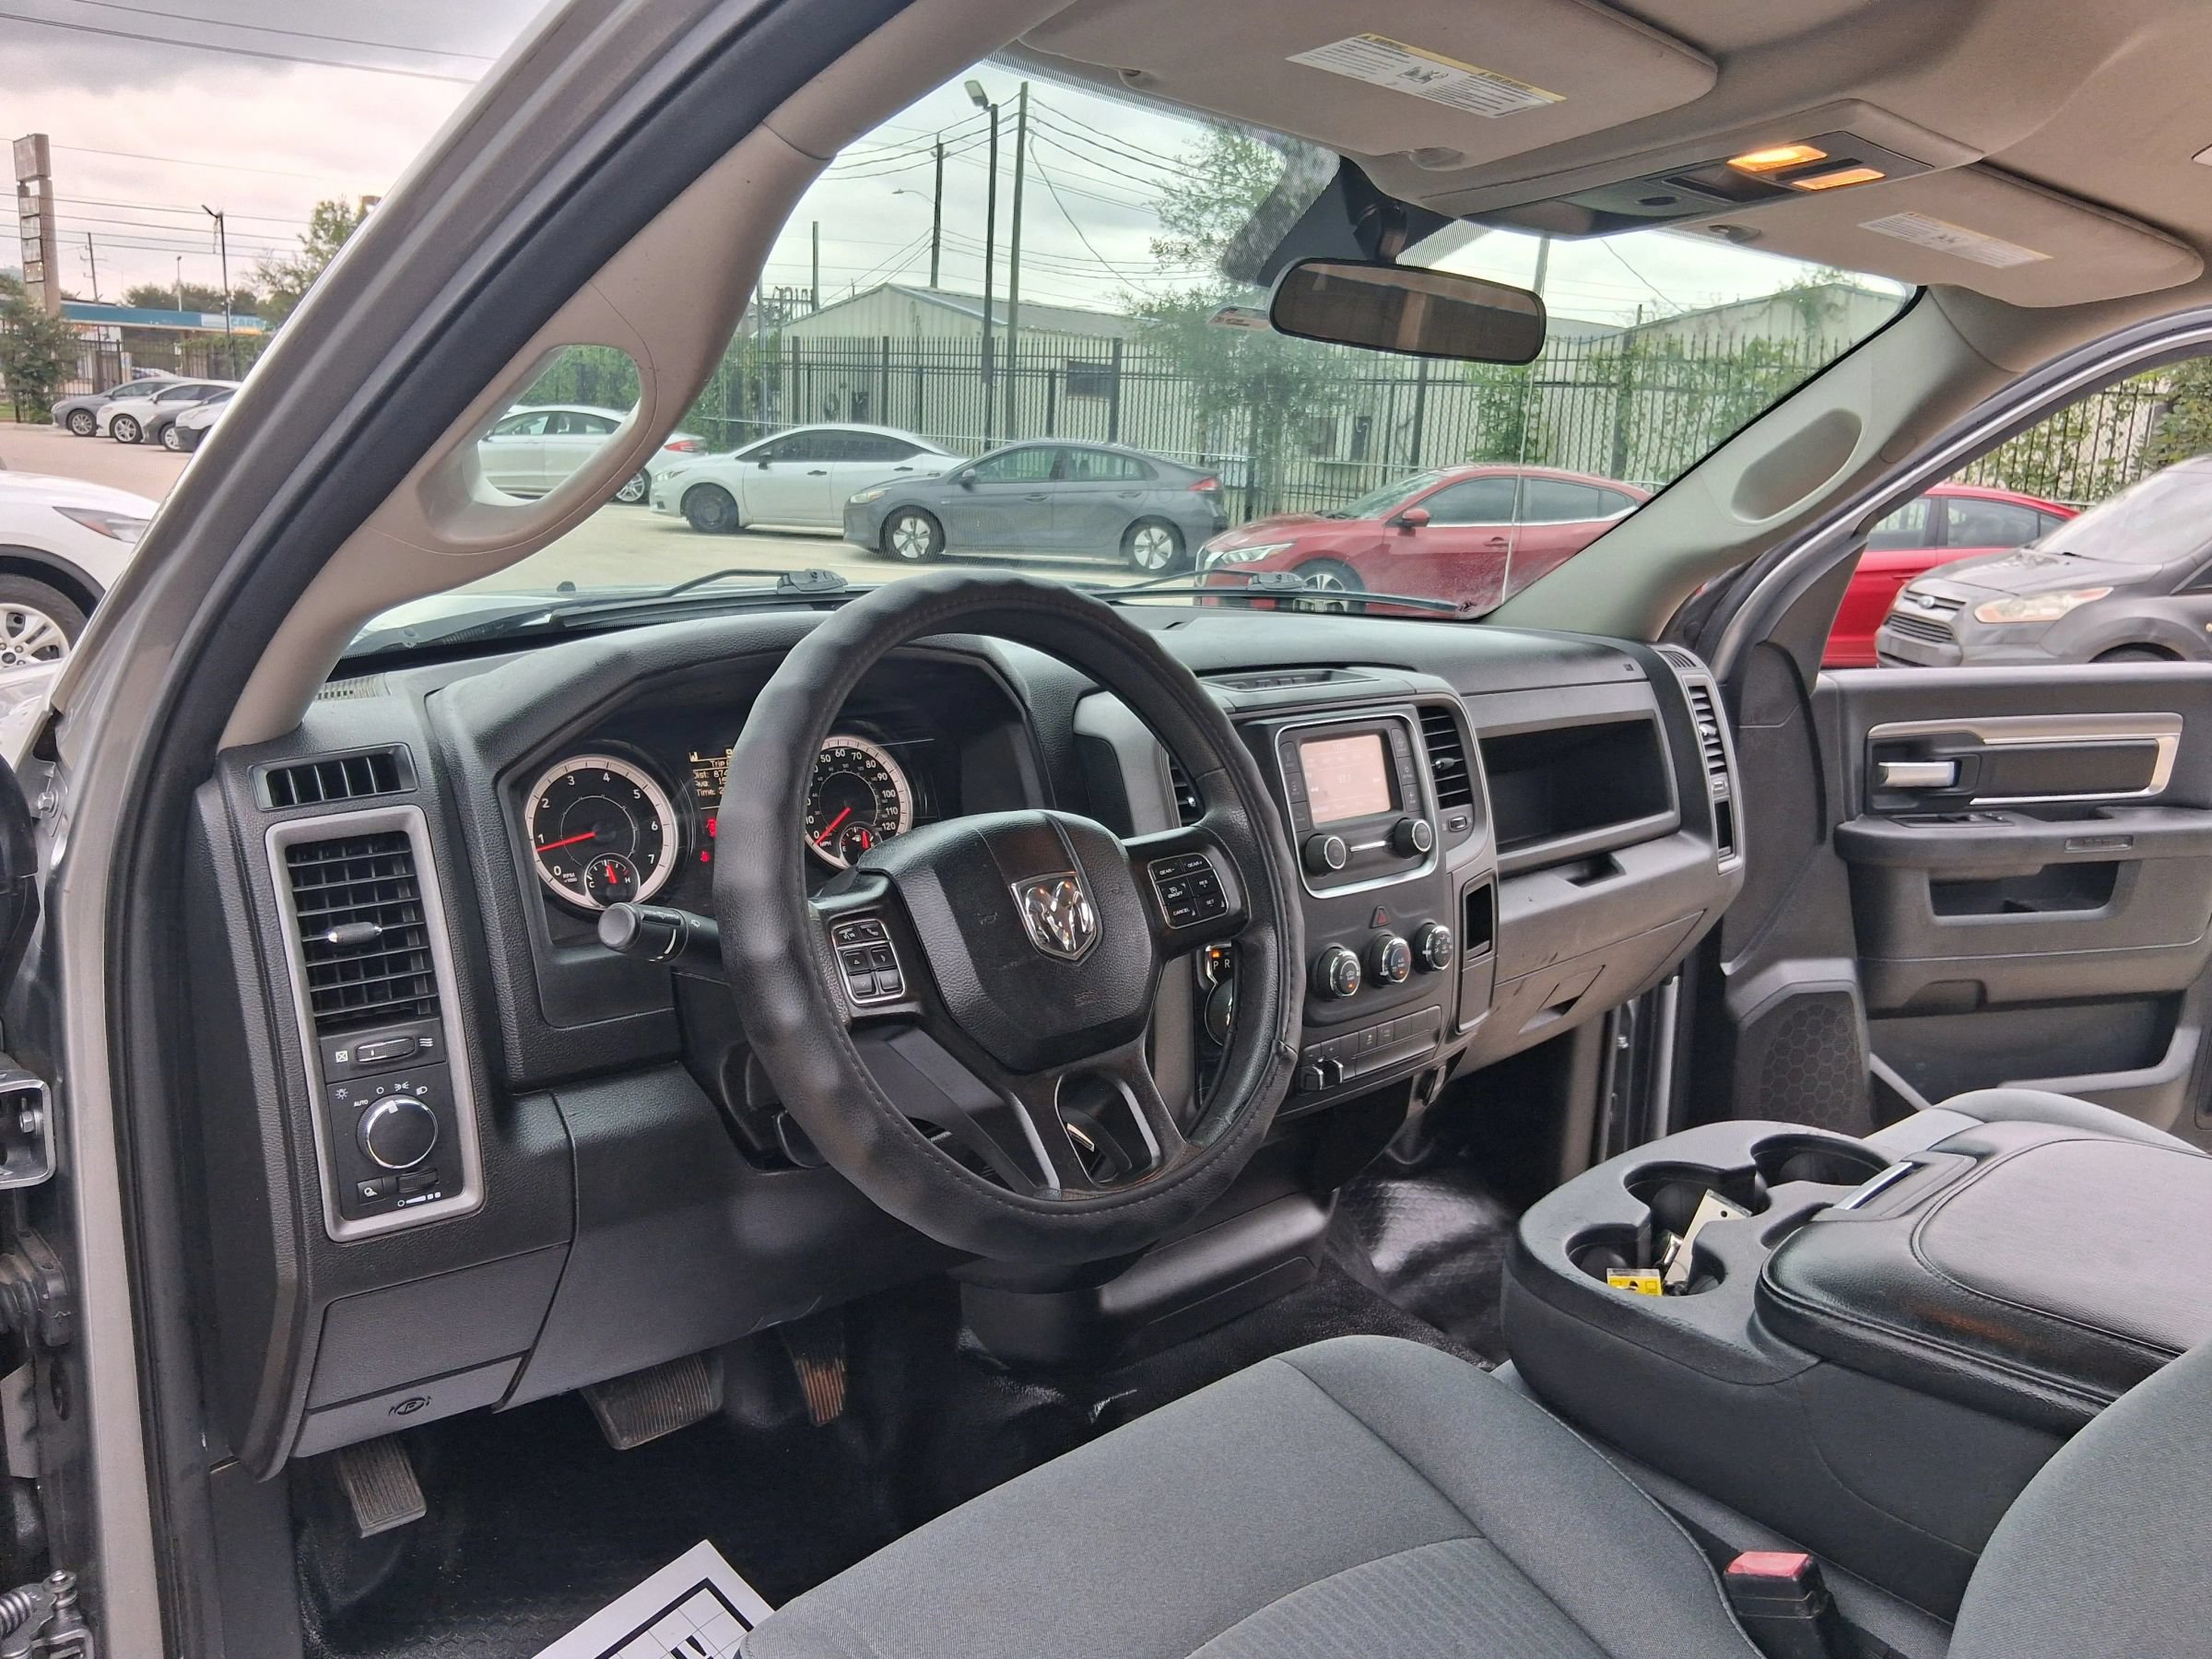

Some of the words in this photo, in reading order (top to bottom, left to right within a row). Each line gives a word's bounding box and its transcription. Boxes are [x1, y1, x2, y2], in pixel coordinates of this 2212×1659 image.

[835, 748, 845, 758] 60
[851, 752, 862, 760] 70
[820, 754, 831, 763] 50
[710, 759, 724, 768] Trip
[865, 760, 877, 769] 80
[567, 776, 575, 786] 3
[603, 772, 610, 782] 4
[877, 772, 888, 781] 90
[633, 789, 641, 799] 5
[697, 788, 715, 796] Time:
[882, 790, 896, 798] 100
[541, 798, 550, 808] 2
[886, 806, 899, 815] 110
[651, 820, 658, 830] 6
[882, 821, 896, 830] 120
[537, 833, 545, 843] 1
[814, 830, 819, 839] 0
[647, 853, 655, 865] 7
[553, 865, 561, 877] 0
[1173, 907, 1190, 916] CANCEL
[1213, 960, 1219, 971] P
[1224, 959, 1230, 969] R
[353, 1099, 369, 1107] AUTO
